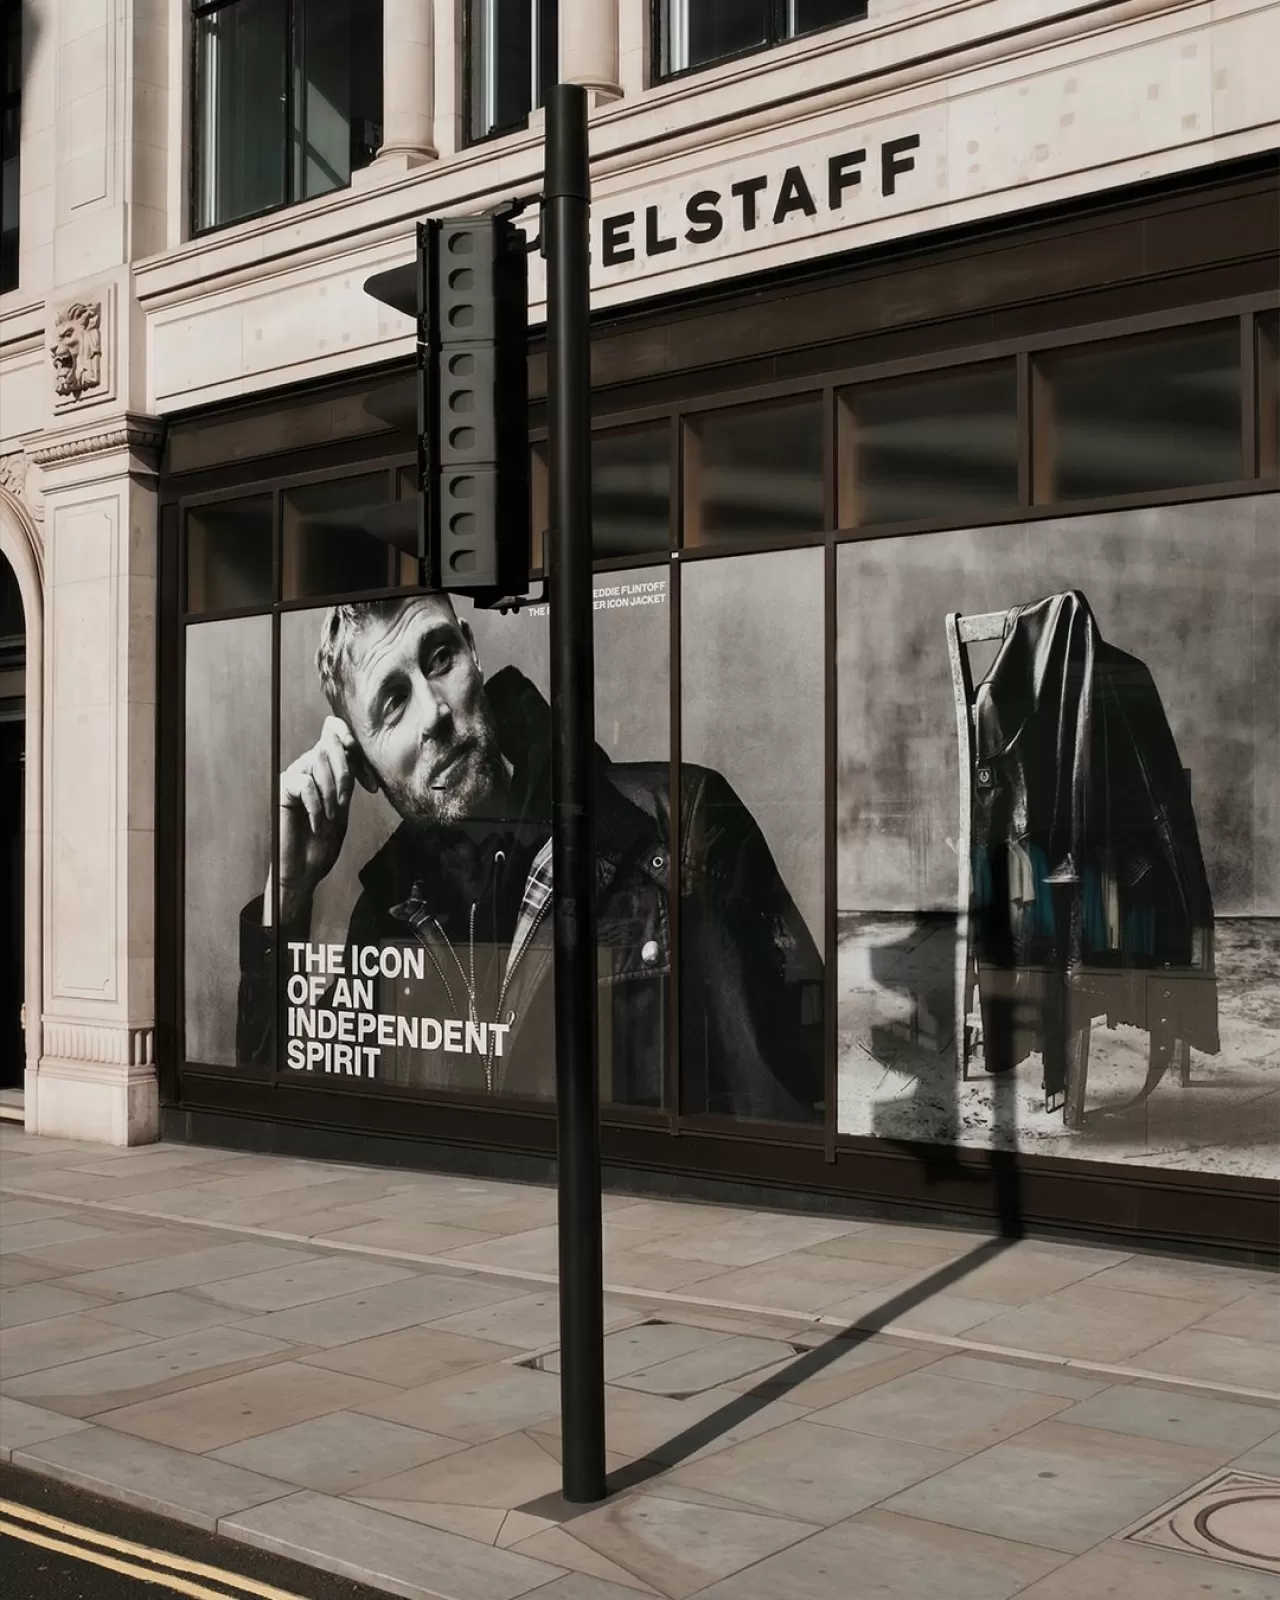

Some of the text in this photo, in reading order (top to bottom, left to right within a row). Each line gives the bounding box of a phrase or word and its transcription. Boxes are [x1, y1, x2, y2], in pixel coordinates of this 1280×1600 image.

[589, 133, 921, 268] ELSTAFF
[528, 606, 546, 617] THE
[607, 597, 629, 609] ICON
[630, 593, 666, 606] JACKET
[621, 581, 666, 595] FLINTOFF
[287, 941, 425, 980] THE ICON
[287, 974, 374, 1011] OF AN
[287, 1006, 510, 1057] INDEPENDENT
[287, 1038, 381, 1078] SPIRIT
